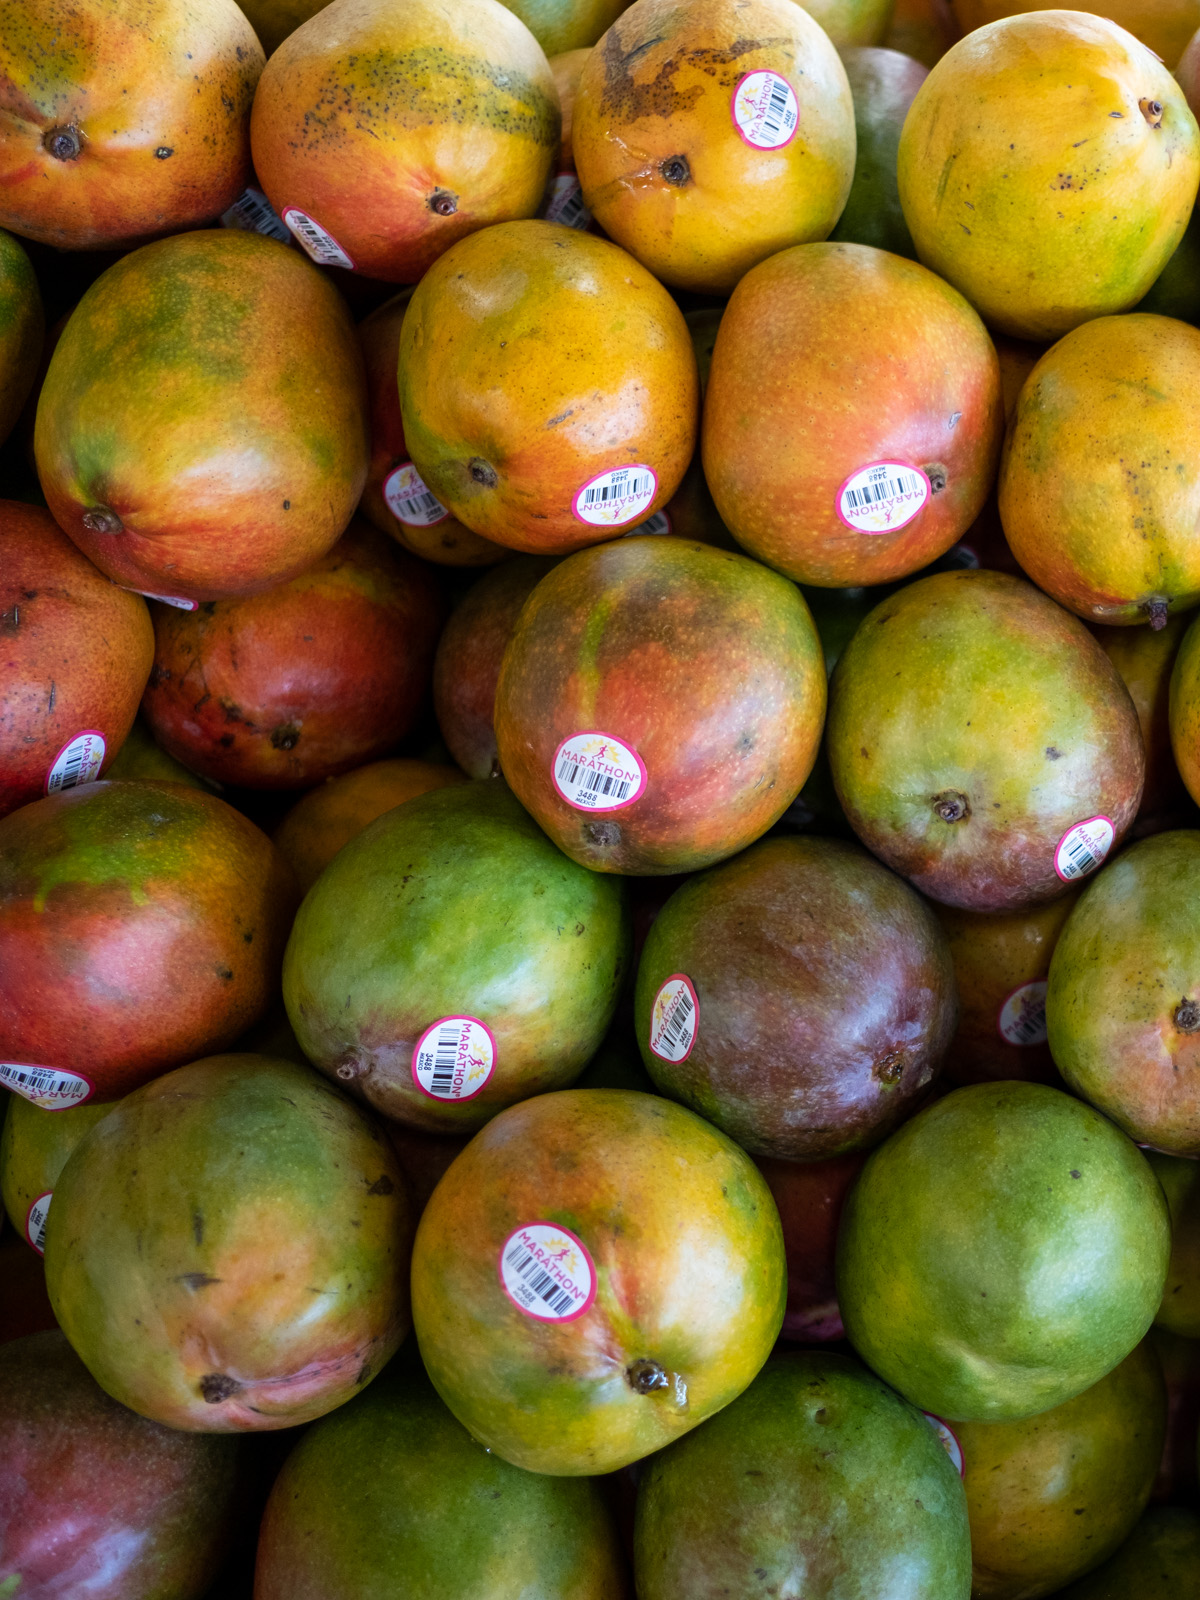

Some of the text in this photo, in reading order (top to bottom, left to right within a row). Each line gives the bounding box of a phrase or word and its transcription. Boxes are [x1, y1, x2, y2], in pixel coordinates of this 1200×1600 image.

[575, 797, 596, 807] MEXICO
[577, 790, 598, 801] 3488
[425, 1053, 434, 1071] 3488
[517, 1283, 537, 1303] 3488
